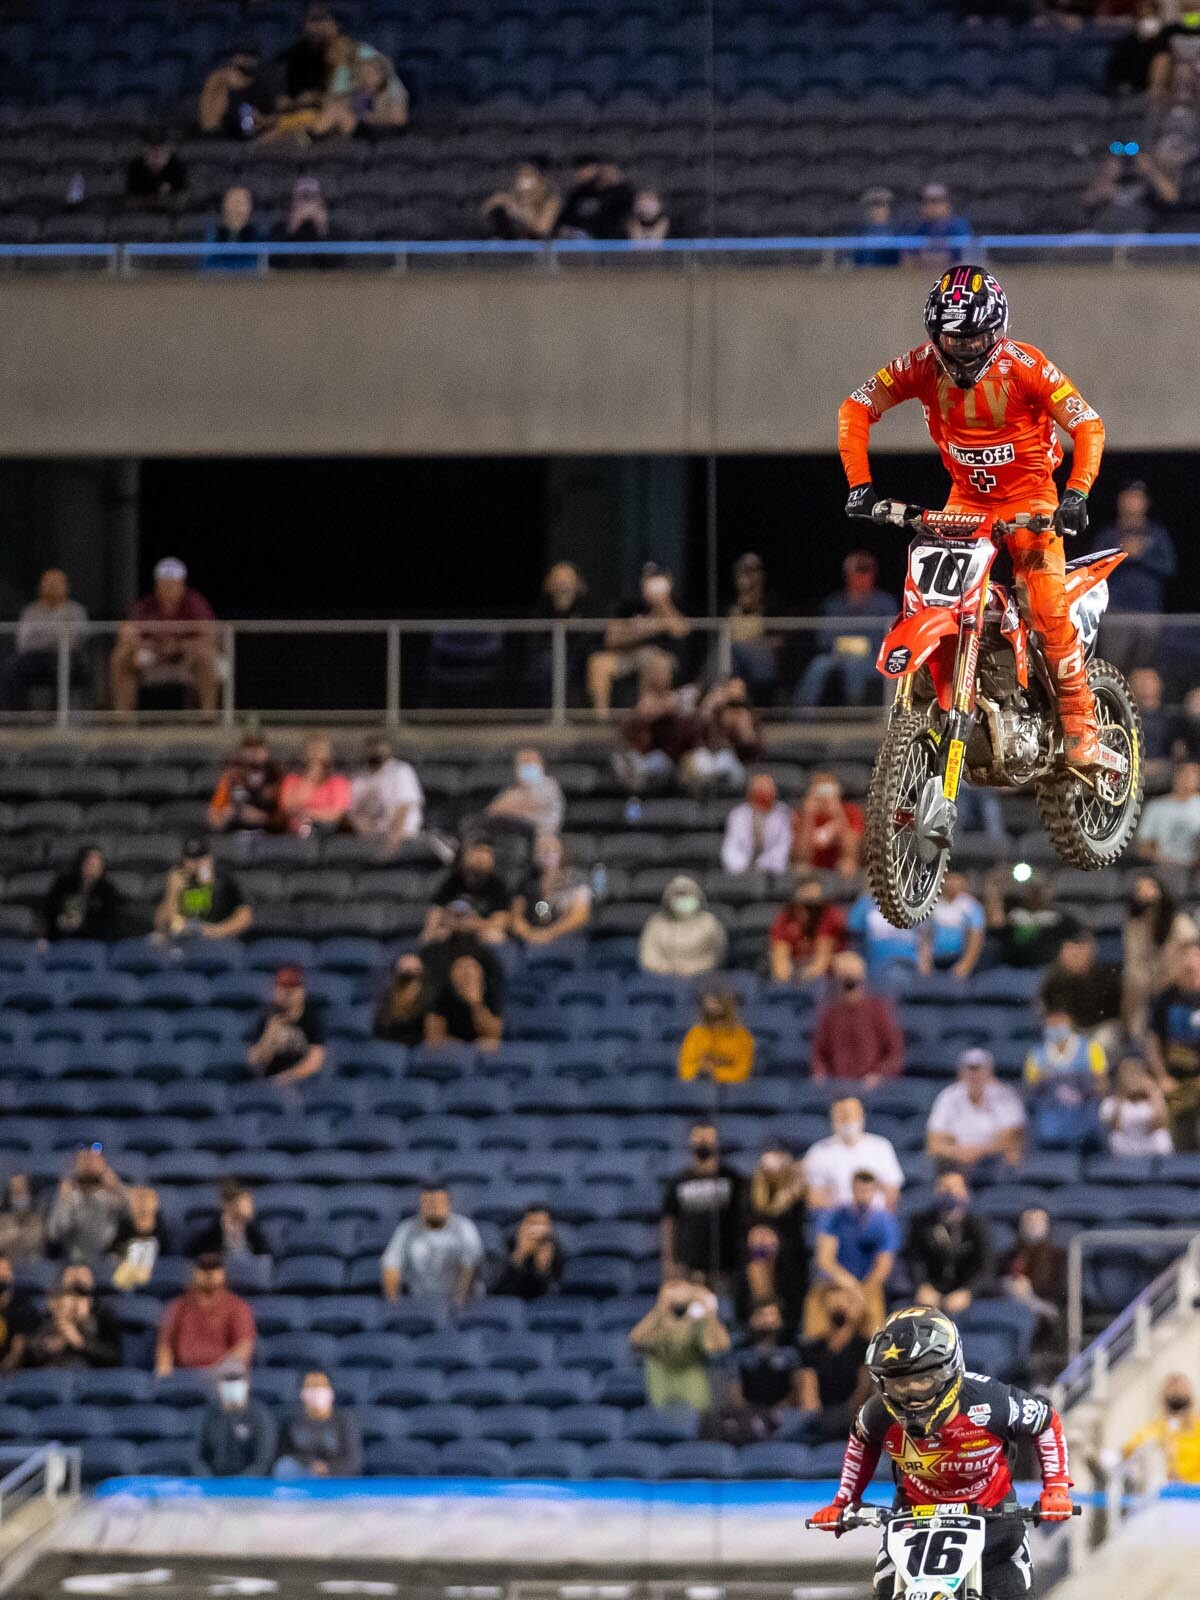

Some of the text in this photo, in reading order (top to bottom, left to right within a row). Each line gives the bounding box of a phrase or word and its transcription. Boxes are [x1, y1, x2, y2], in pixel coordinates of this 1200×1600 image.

[950, 446, 1012, 465] Muc-Off
[918, 551, 974, 597] 10
[940, 1461, 963, 1473] FLY
[904, 1530, 968, 1577] 16
